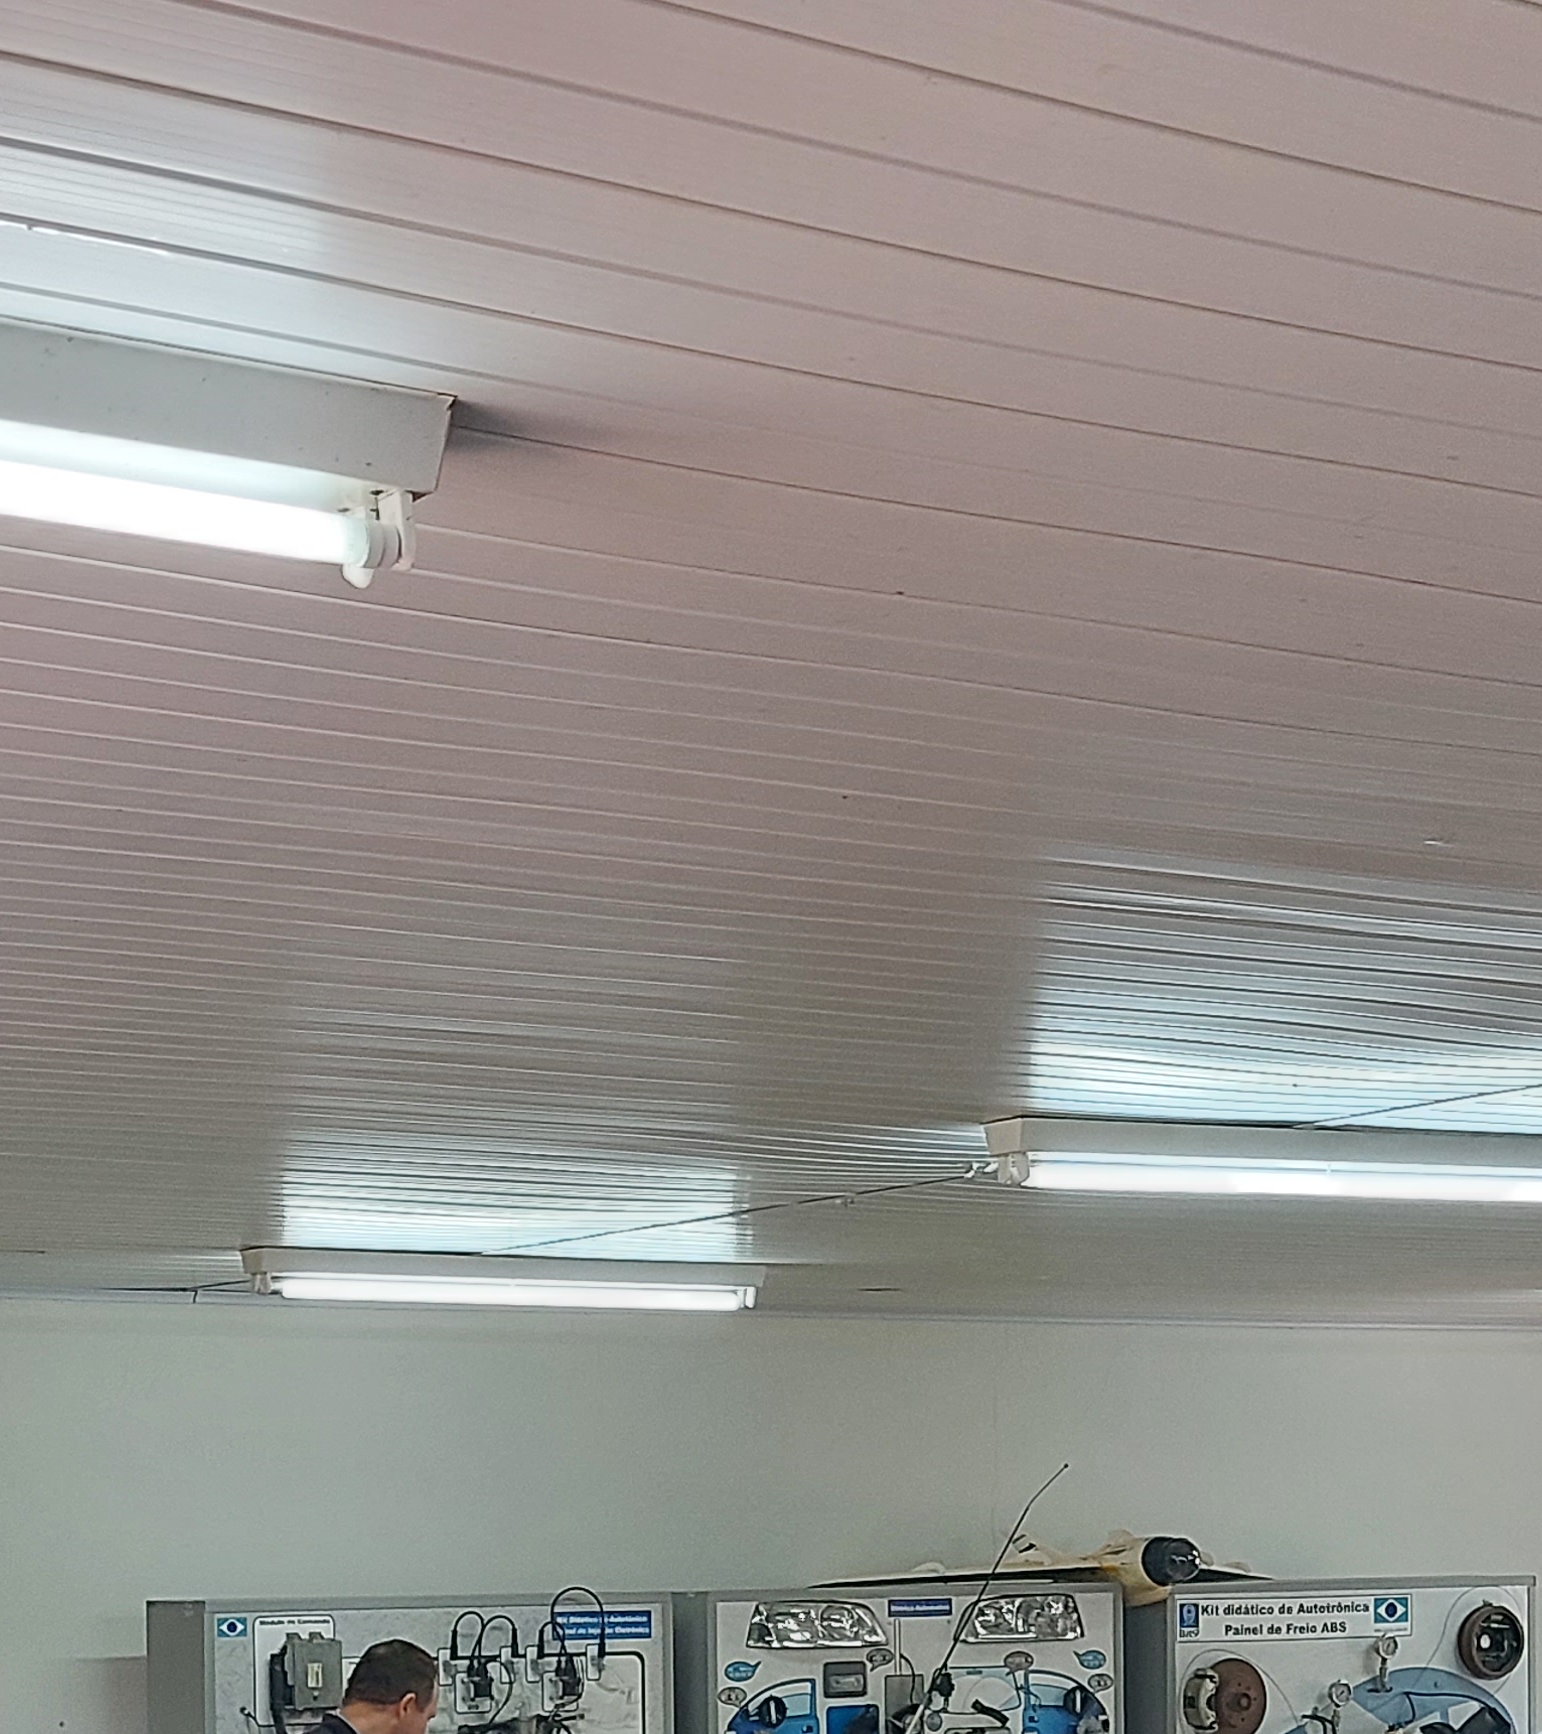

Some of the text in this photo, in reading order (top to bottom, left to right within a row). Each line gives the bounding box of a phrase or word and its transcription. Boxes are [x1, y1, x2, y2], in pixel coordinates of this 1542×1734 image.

[1201, 1601, 1370, 1616] Kit didático de Autotrônica
[1225, 1621, 1347, 1636] Painel de Freio ABS
